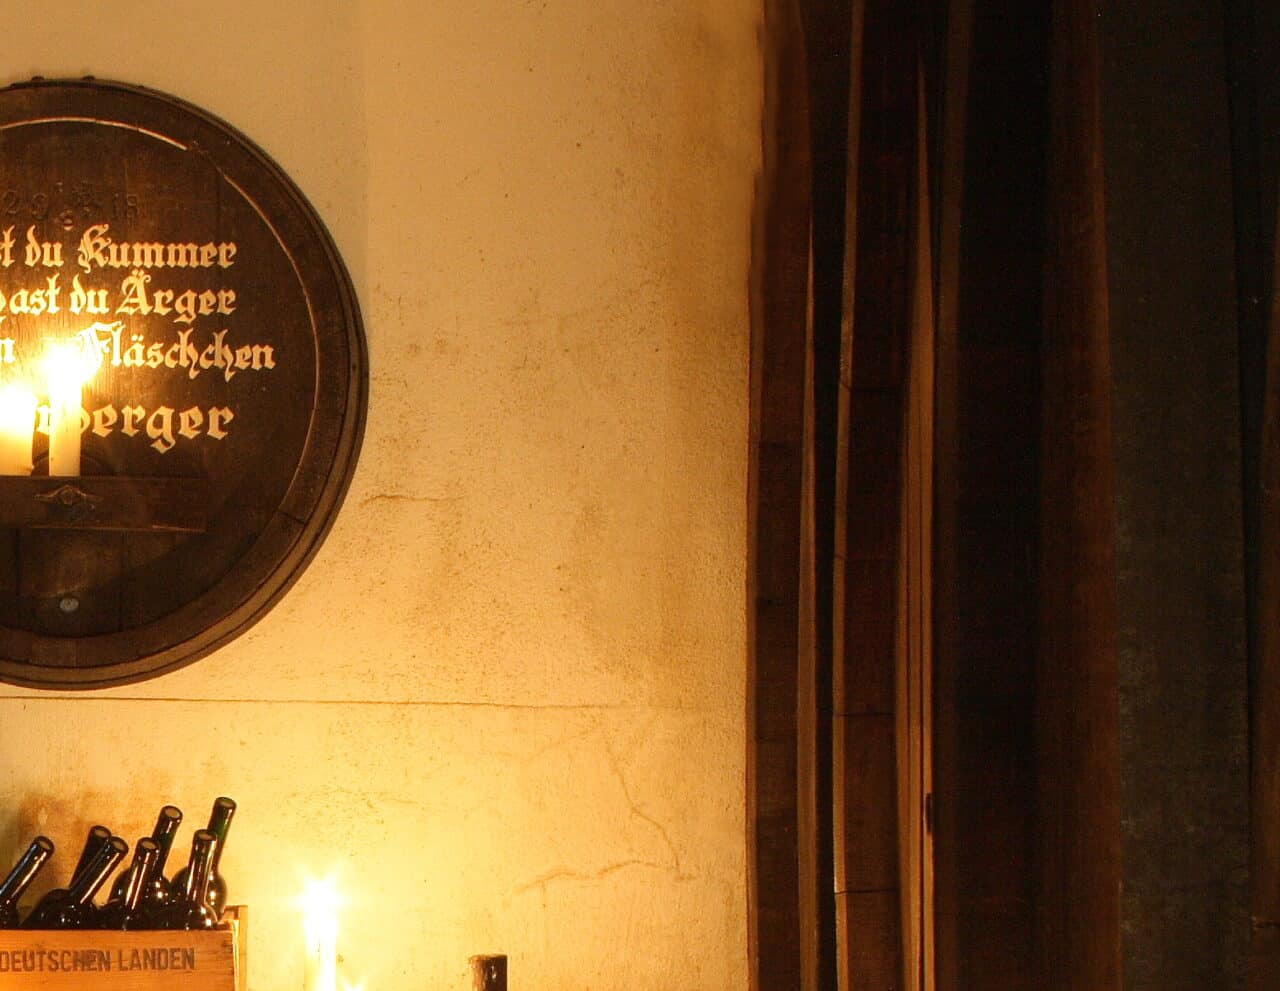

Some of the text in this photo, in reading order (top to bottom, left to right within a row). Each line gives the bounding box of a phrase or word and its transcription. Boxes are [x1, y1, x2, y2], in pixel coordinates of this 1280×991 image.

[25, 226, 64, 268] du
[77, 223, 237, 272] Kummer
[69, 275, 110, 314] du
[116, 270, 237, 323] Ärger
[119, 947, 196, 971] LANDEN
